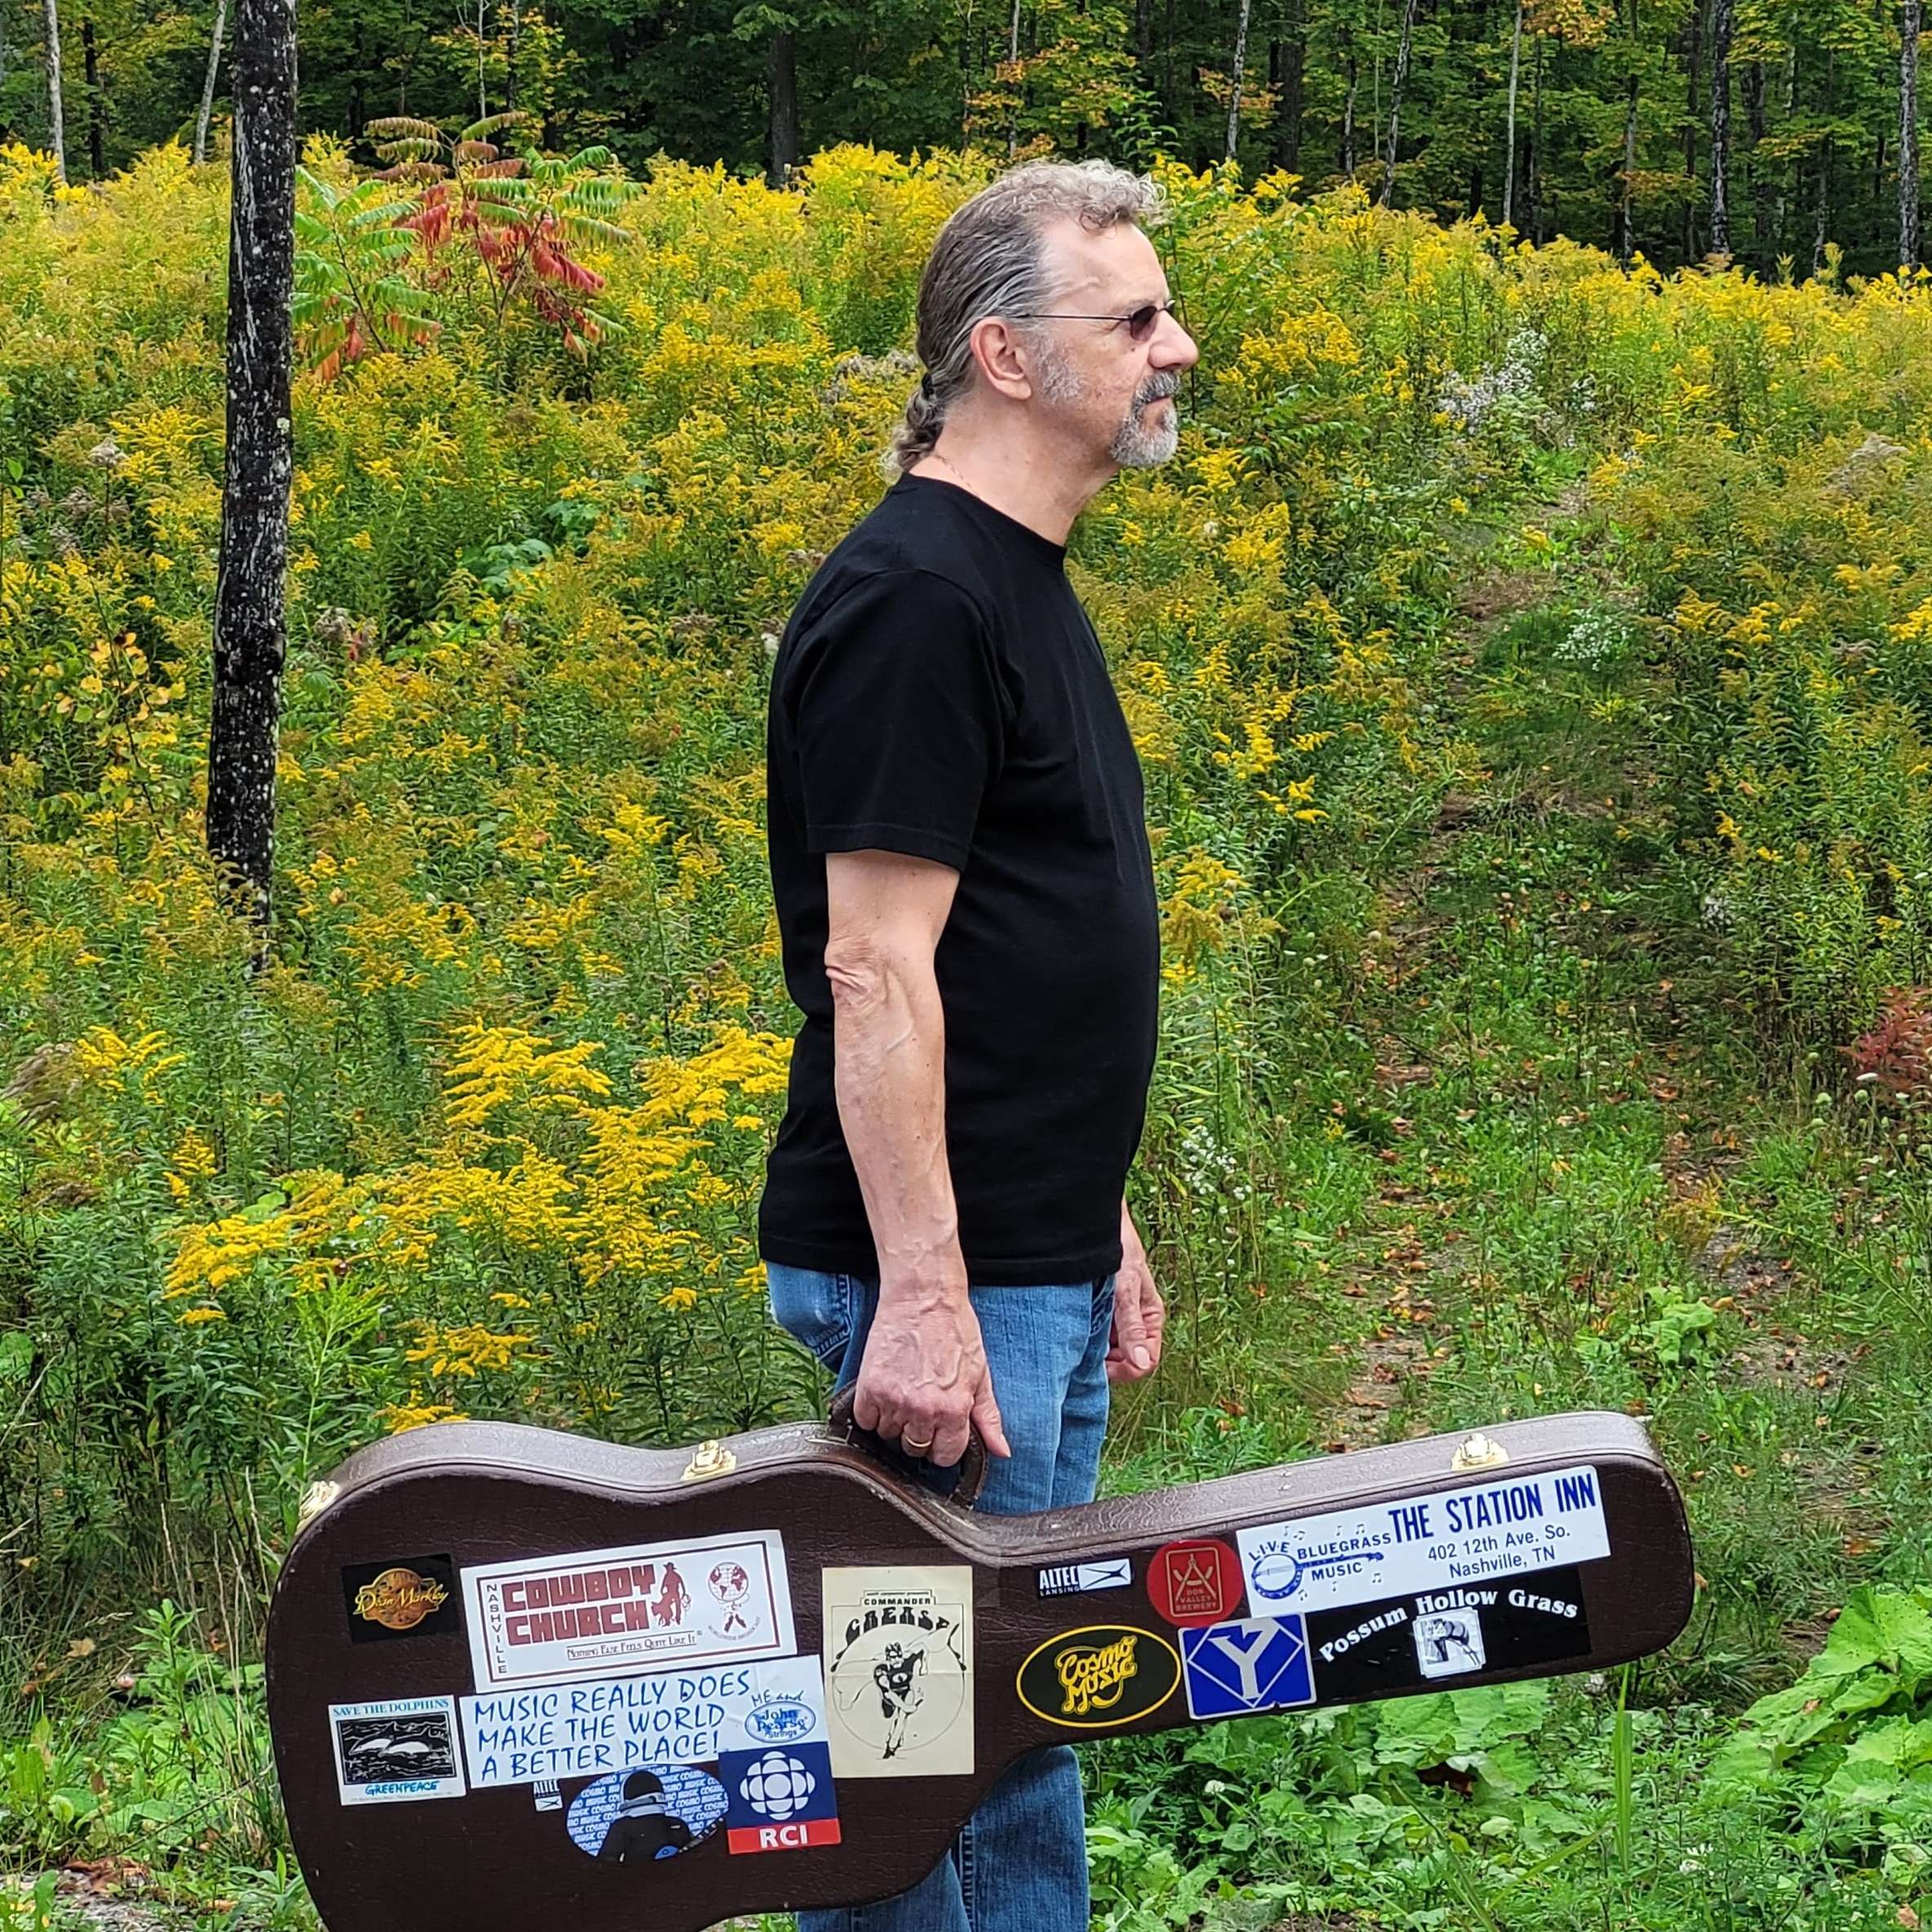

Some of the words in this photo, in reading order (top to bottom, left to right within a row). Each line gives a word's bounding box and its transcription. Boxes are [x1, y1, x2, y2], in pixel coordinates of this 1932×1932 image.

[1388, 1504, 1434, 1543] THE
[1445, 1483, 1544, 1533] STATION
[1554, 1473, 1596, 1513] INN
[1297, 1532, 1391, 1560] BLUEGRASS
[1428, 1543, 1457, 1561] 402
[1463, 1536, 1498, 1554] 12th
[1505, 1532, 1539, 1547] Ave.
[1545, 1524, 1571, 1540] So.
[1040, 1566, 1078, 1589] ALTEC
[1311, 1562, 1363, 1581] MUSIC
[1449, 1553, 1527, 1579] Nashville,
[1532, 1545, 1556, 1563] TN
[352, 1590, 396, 1615] Dean
[397, 1583, 449, 1606] Markley
[501, 1563, 656, 1612] COWBOY
[1040, 1585, 1080, 1597] LANSING
[505, 1599, 650, 1646] CHURCH
[1176, 1603, 1217, 1611] BREWERY
[486, 1584, 508, 1673] NASHVILLE
[1319, 1607, 1408, 1662] Possum
[1415, 1589, 1498, 1615] Hollow
[1508, 1589, 1578, 1619] Grass
[334, 1706, 360, 1716] SAVE
[363, 1704, 387, 1713] THE
[389, 1699, 449, 1713] DOLPHINS
[475, 1694, 558, 1725] MUSIC
[571, 1680, 667, 1713] REALLY
[678, 1670, 751, 1701] DOES
[751, 1689, 771, 1707] ME
[479, 1722, 554, 1752] MAKE
[565, 1714, 616, 1743] THE
[628, 1703, 725, 1735] WORLD
[763, 1708, 798, 1721] John
[482, 1756, 497, 1781] A
[511, 1744, 614, 1779] BETTER
[625, 1731, 719, 1766] PLACE!
[365, 1780, 440, 1796] GREENPEACE
[758, 1825, 809, 1849] RCI
